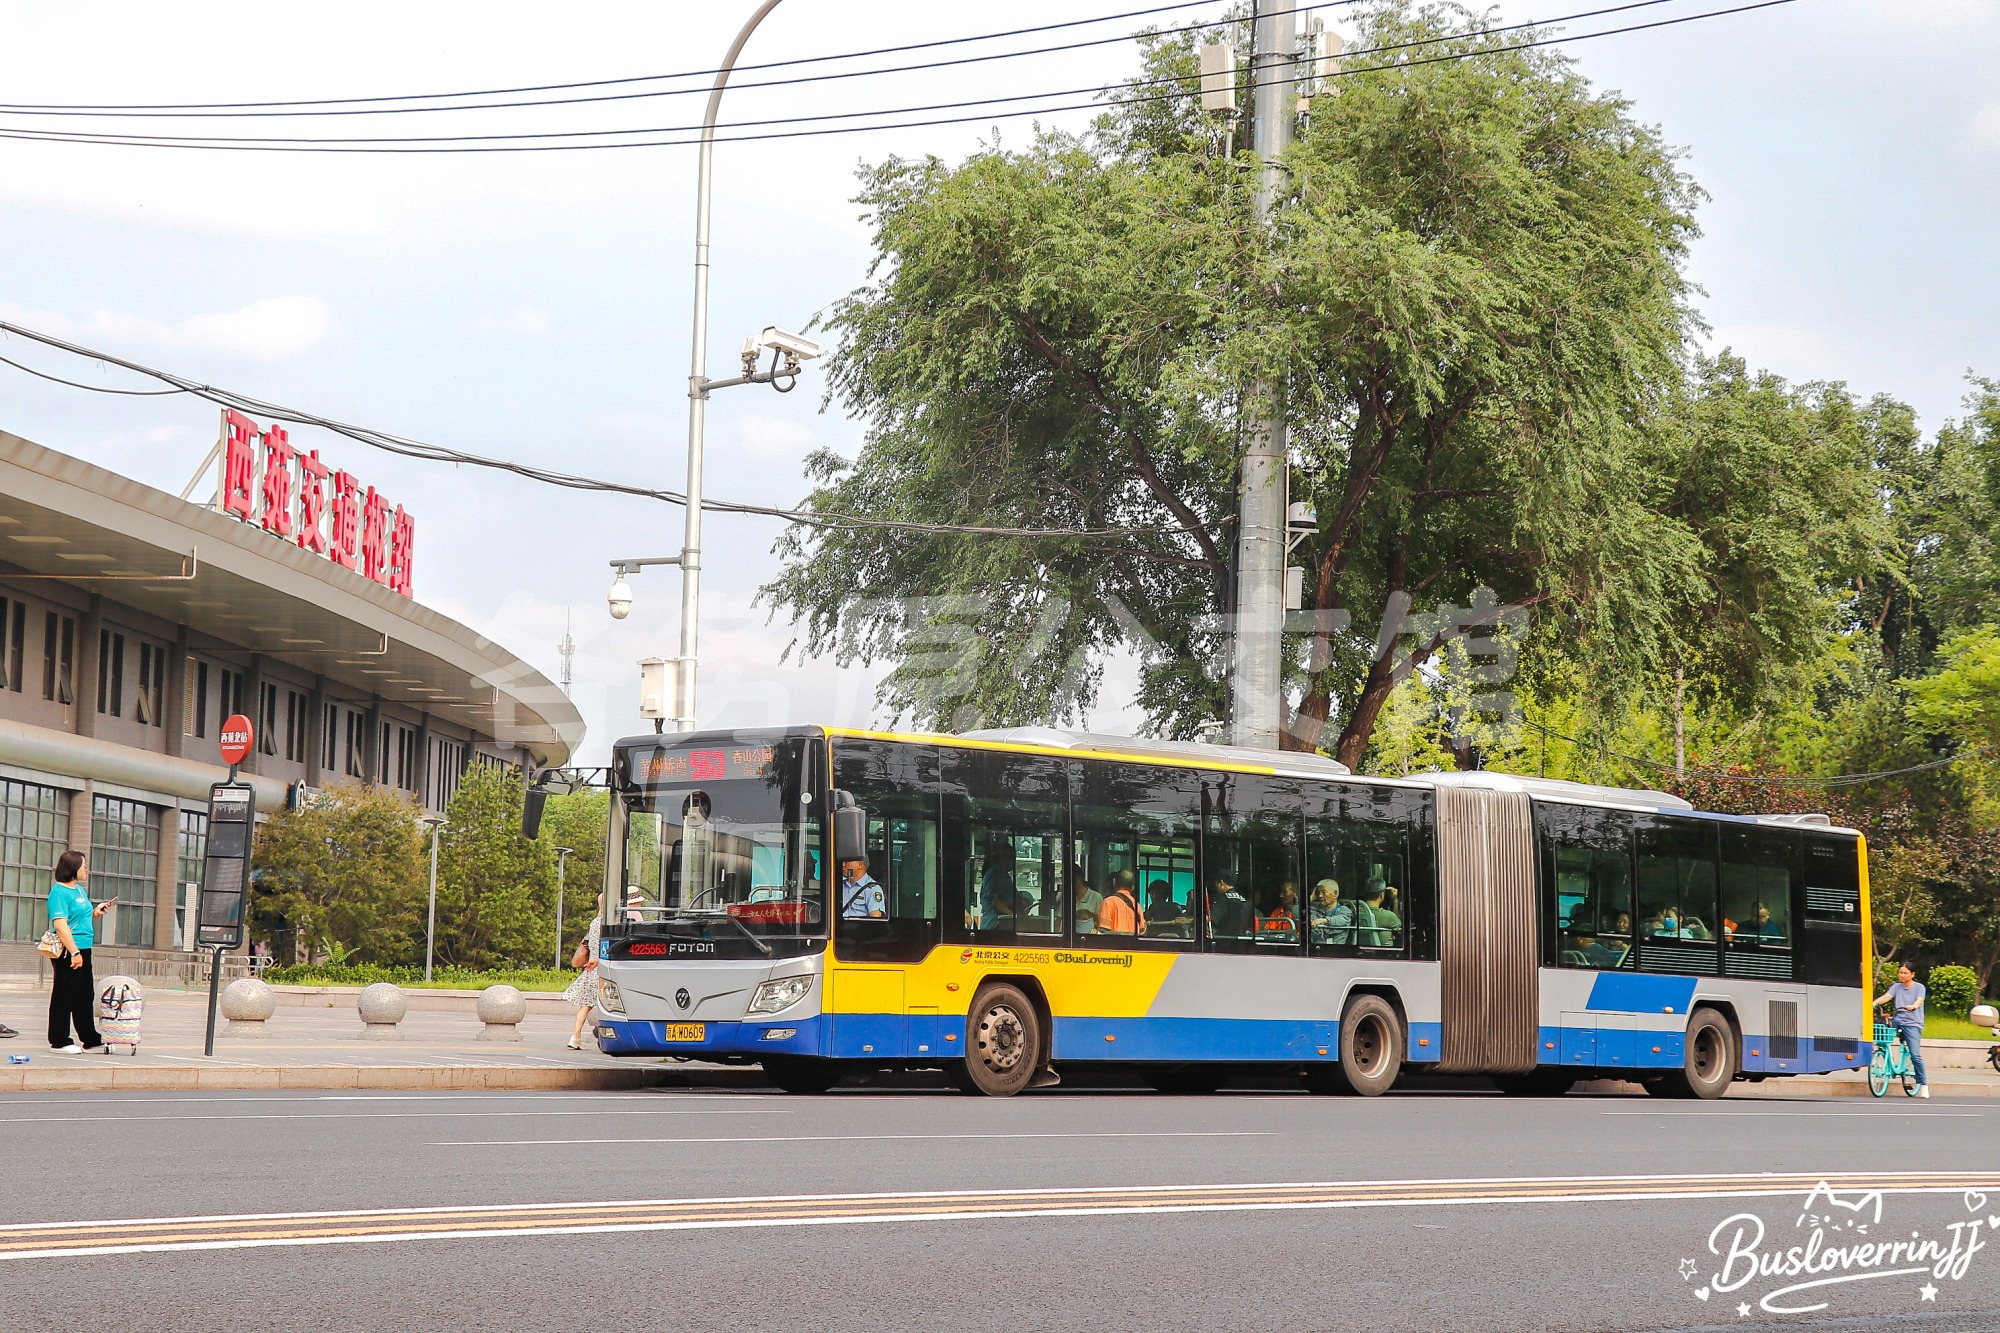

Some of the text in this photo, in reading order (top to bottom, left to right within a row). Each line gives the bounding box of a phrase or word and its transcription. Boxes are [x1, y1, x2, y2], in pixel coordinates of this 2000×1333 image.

[224, 408, 414, 600] 西苑交通枢纽
[220, 731, 248, 743] 西苑北站
[732, 747, 774, 765] 香山公园
[689, 749, 725, 780] 563
[629, 942, 714, 955] 4225563 FOTON
[975, 950, 1010, 960] 北京公交
[1013, 952, 1050, 964] 4225563
